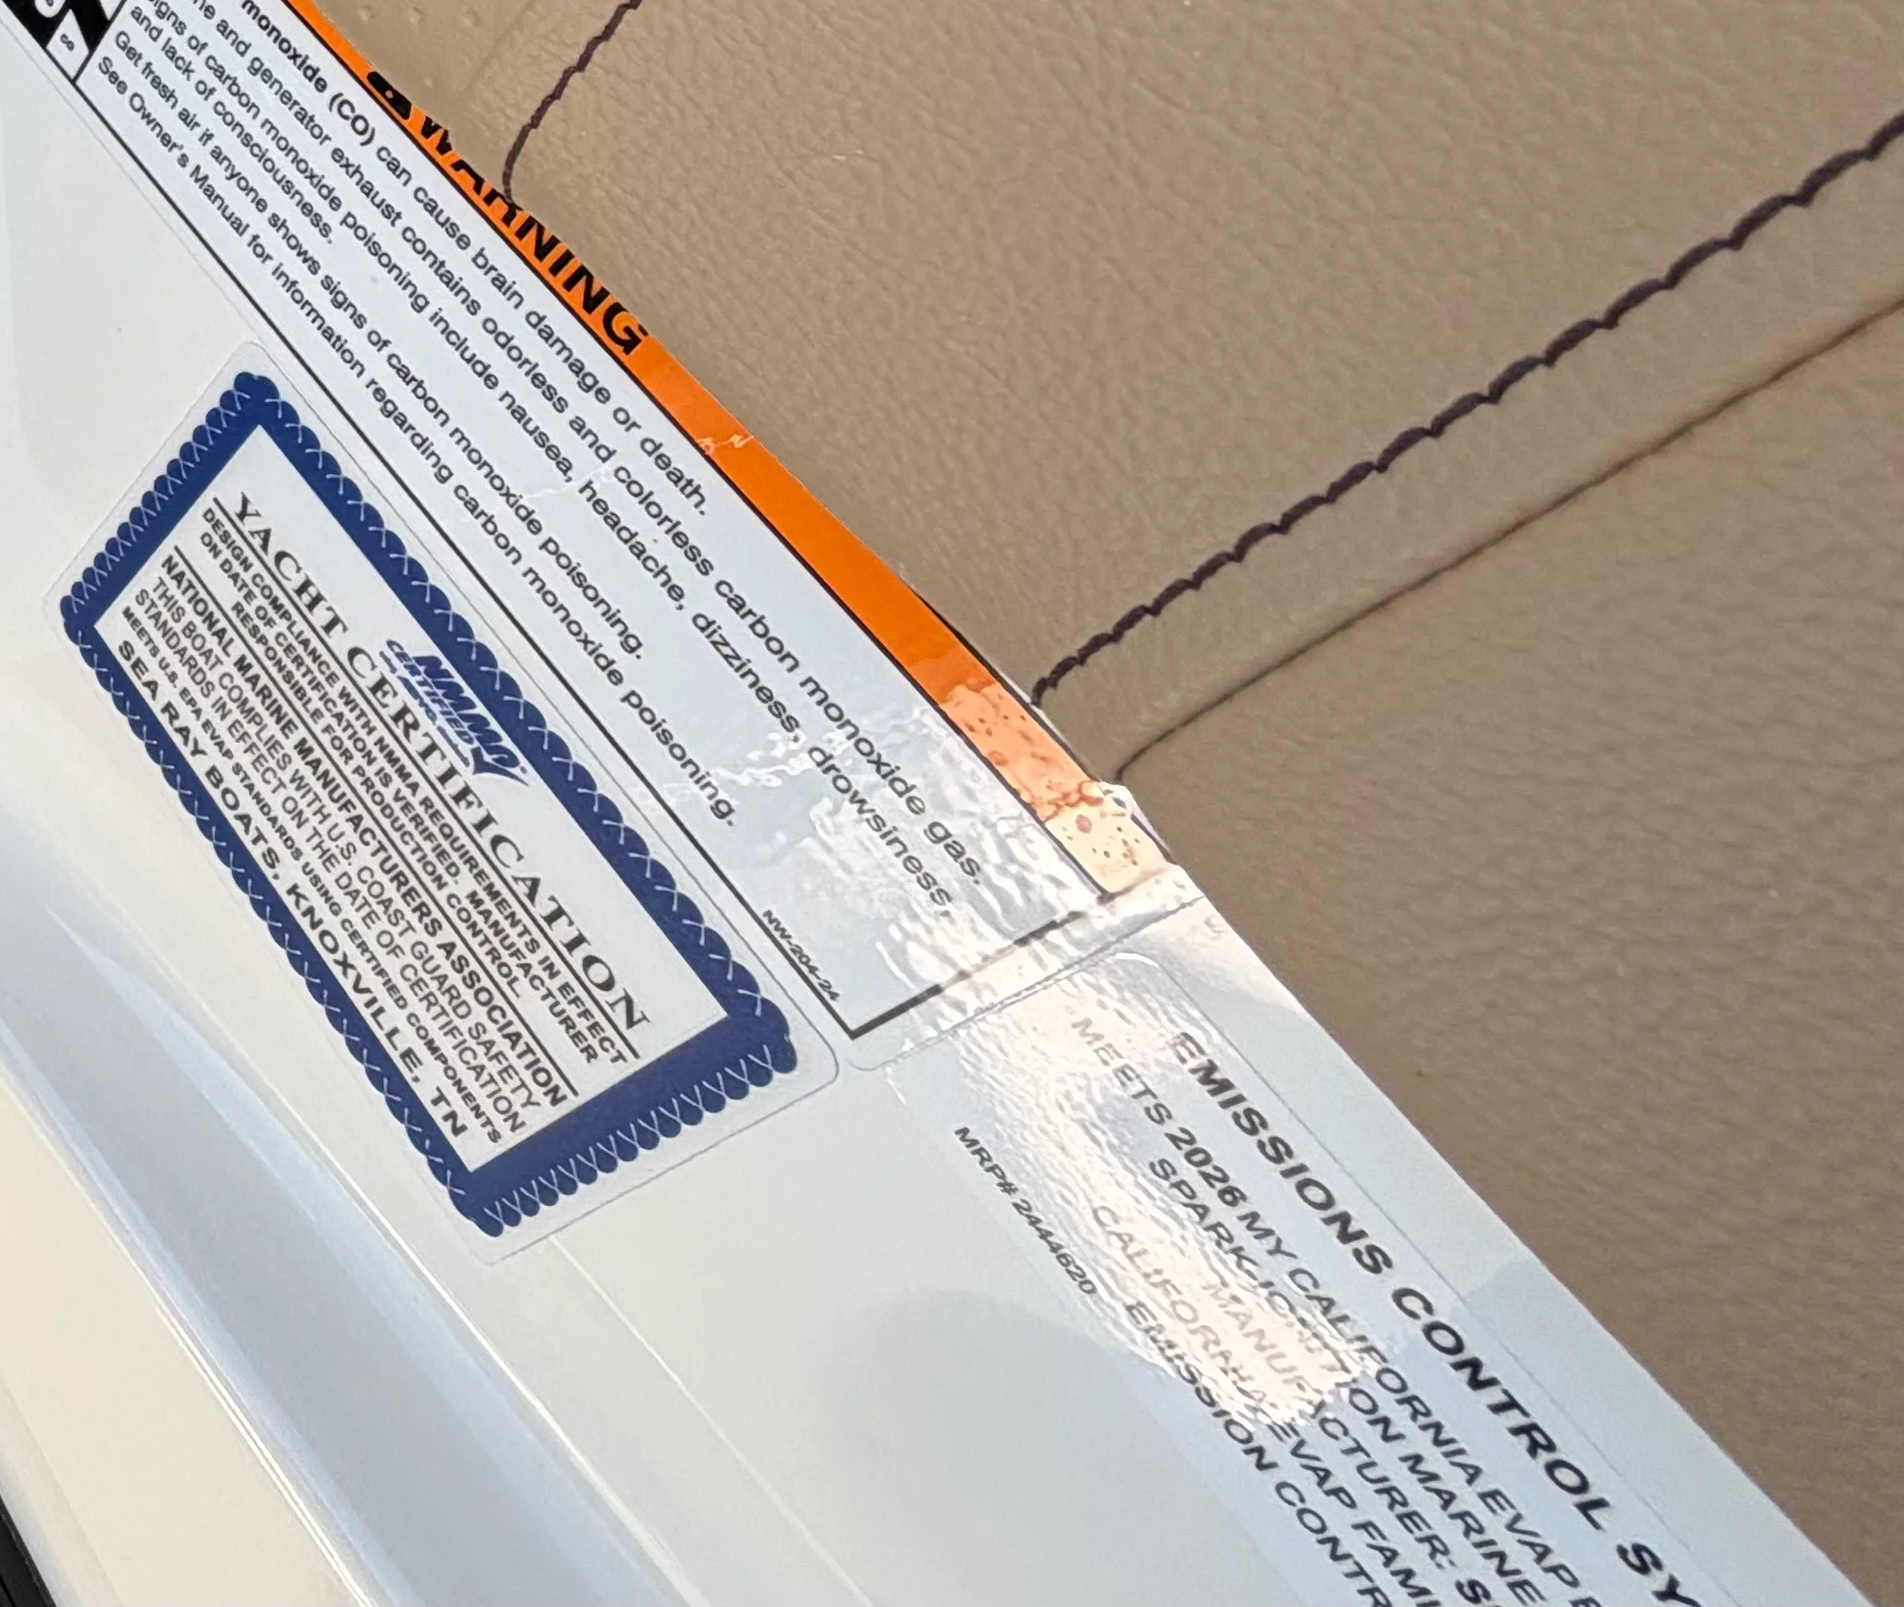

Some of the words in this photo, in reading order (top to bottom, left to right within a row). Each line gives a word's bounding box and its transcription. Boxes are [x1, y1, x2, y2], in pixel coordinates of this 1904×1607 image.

[98, 57, 124, 87] See
[129, 92, 188, 167] Owner's
[189, 164, 250, 237] Manual
[247, 234, 274, 264] for
[272, 262, 365, 379] information
[365, 378, 454, 484] regarding
[453, 484, 522, 565] carbon
[522, 567, 623, 685] monoxide
[620, 689, 735, 826] poisoning.
[216, 20, 252, 57] and
[247, 56, 332, 145] generator
[332, 148, 402, 227] exhaust
[401, 226, 481, 316] contains
[482, 317, 568, 413] odorless
[569, 416, 617, 464] and
[613, 466, 714, 576] colorless
[715, 579, 800, 673] carbon
[799, 676, 925, 815] monoxide
[328, 93, 375, 147] (CO)
[376, 146, 412, 187] can
[413, 187, 470, 250] cause
[471, 247, 524, 310] brain
[525, 311, 610, 403] damage
[612, 407, 641, 432] or
[640, 437, 706, 515] death.
[119, 641, 157, 701] SEA
[160, 701, 208, 757] RAY
[205, 765, 280, 880] BOATS,
[286, 883, 423, 1083] KNOXVILLE,
[430, 1086, 468, 1137] TN
[161, 554, 235, 658] NATIONAL
[233, 654, 299, 740] MARINE
[293, 737, 442, 937] MANUFACTURERS
[436, 941, 568, 1107] ASSOCIATION
[203, 508, 254, 573] DESIGN
[251, 573, 340, 688] COMPLIANCE
[338, 686, 378, 736] WITH
[373, 736, 420, 797] NMMA
[418, 797, 540, 954] REQUIREMENTS
[537, 955, 561, 980] IN
[557, 981, 628, 1063] EFFECT
[235, 492, 348, 637] YACHT
[347, 647, 650, 1030] CERTIFICATION
[1164, 1127, 1248, 1208] 2026
[1237, 1210, 1298, 1260] MY
[1479, 1489, 1581, 1589] EVAP
[1167, 1031, 1394, 1275] EMISSIONS
[1392, 1288, 1611, 1531] CONTROL
[1270, 1422, 1357, 1510] EVAP
[1399, 1452, 1548, 1606] MARINE
